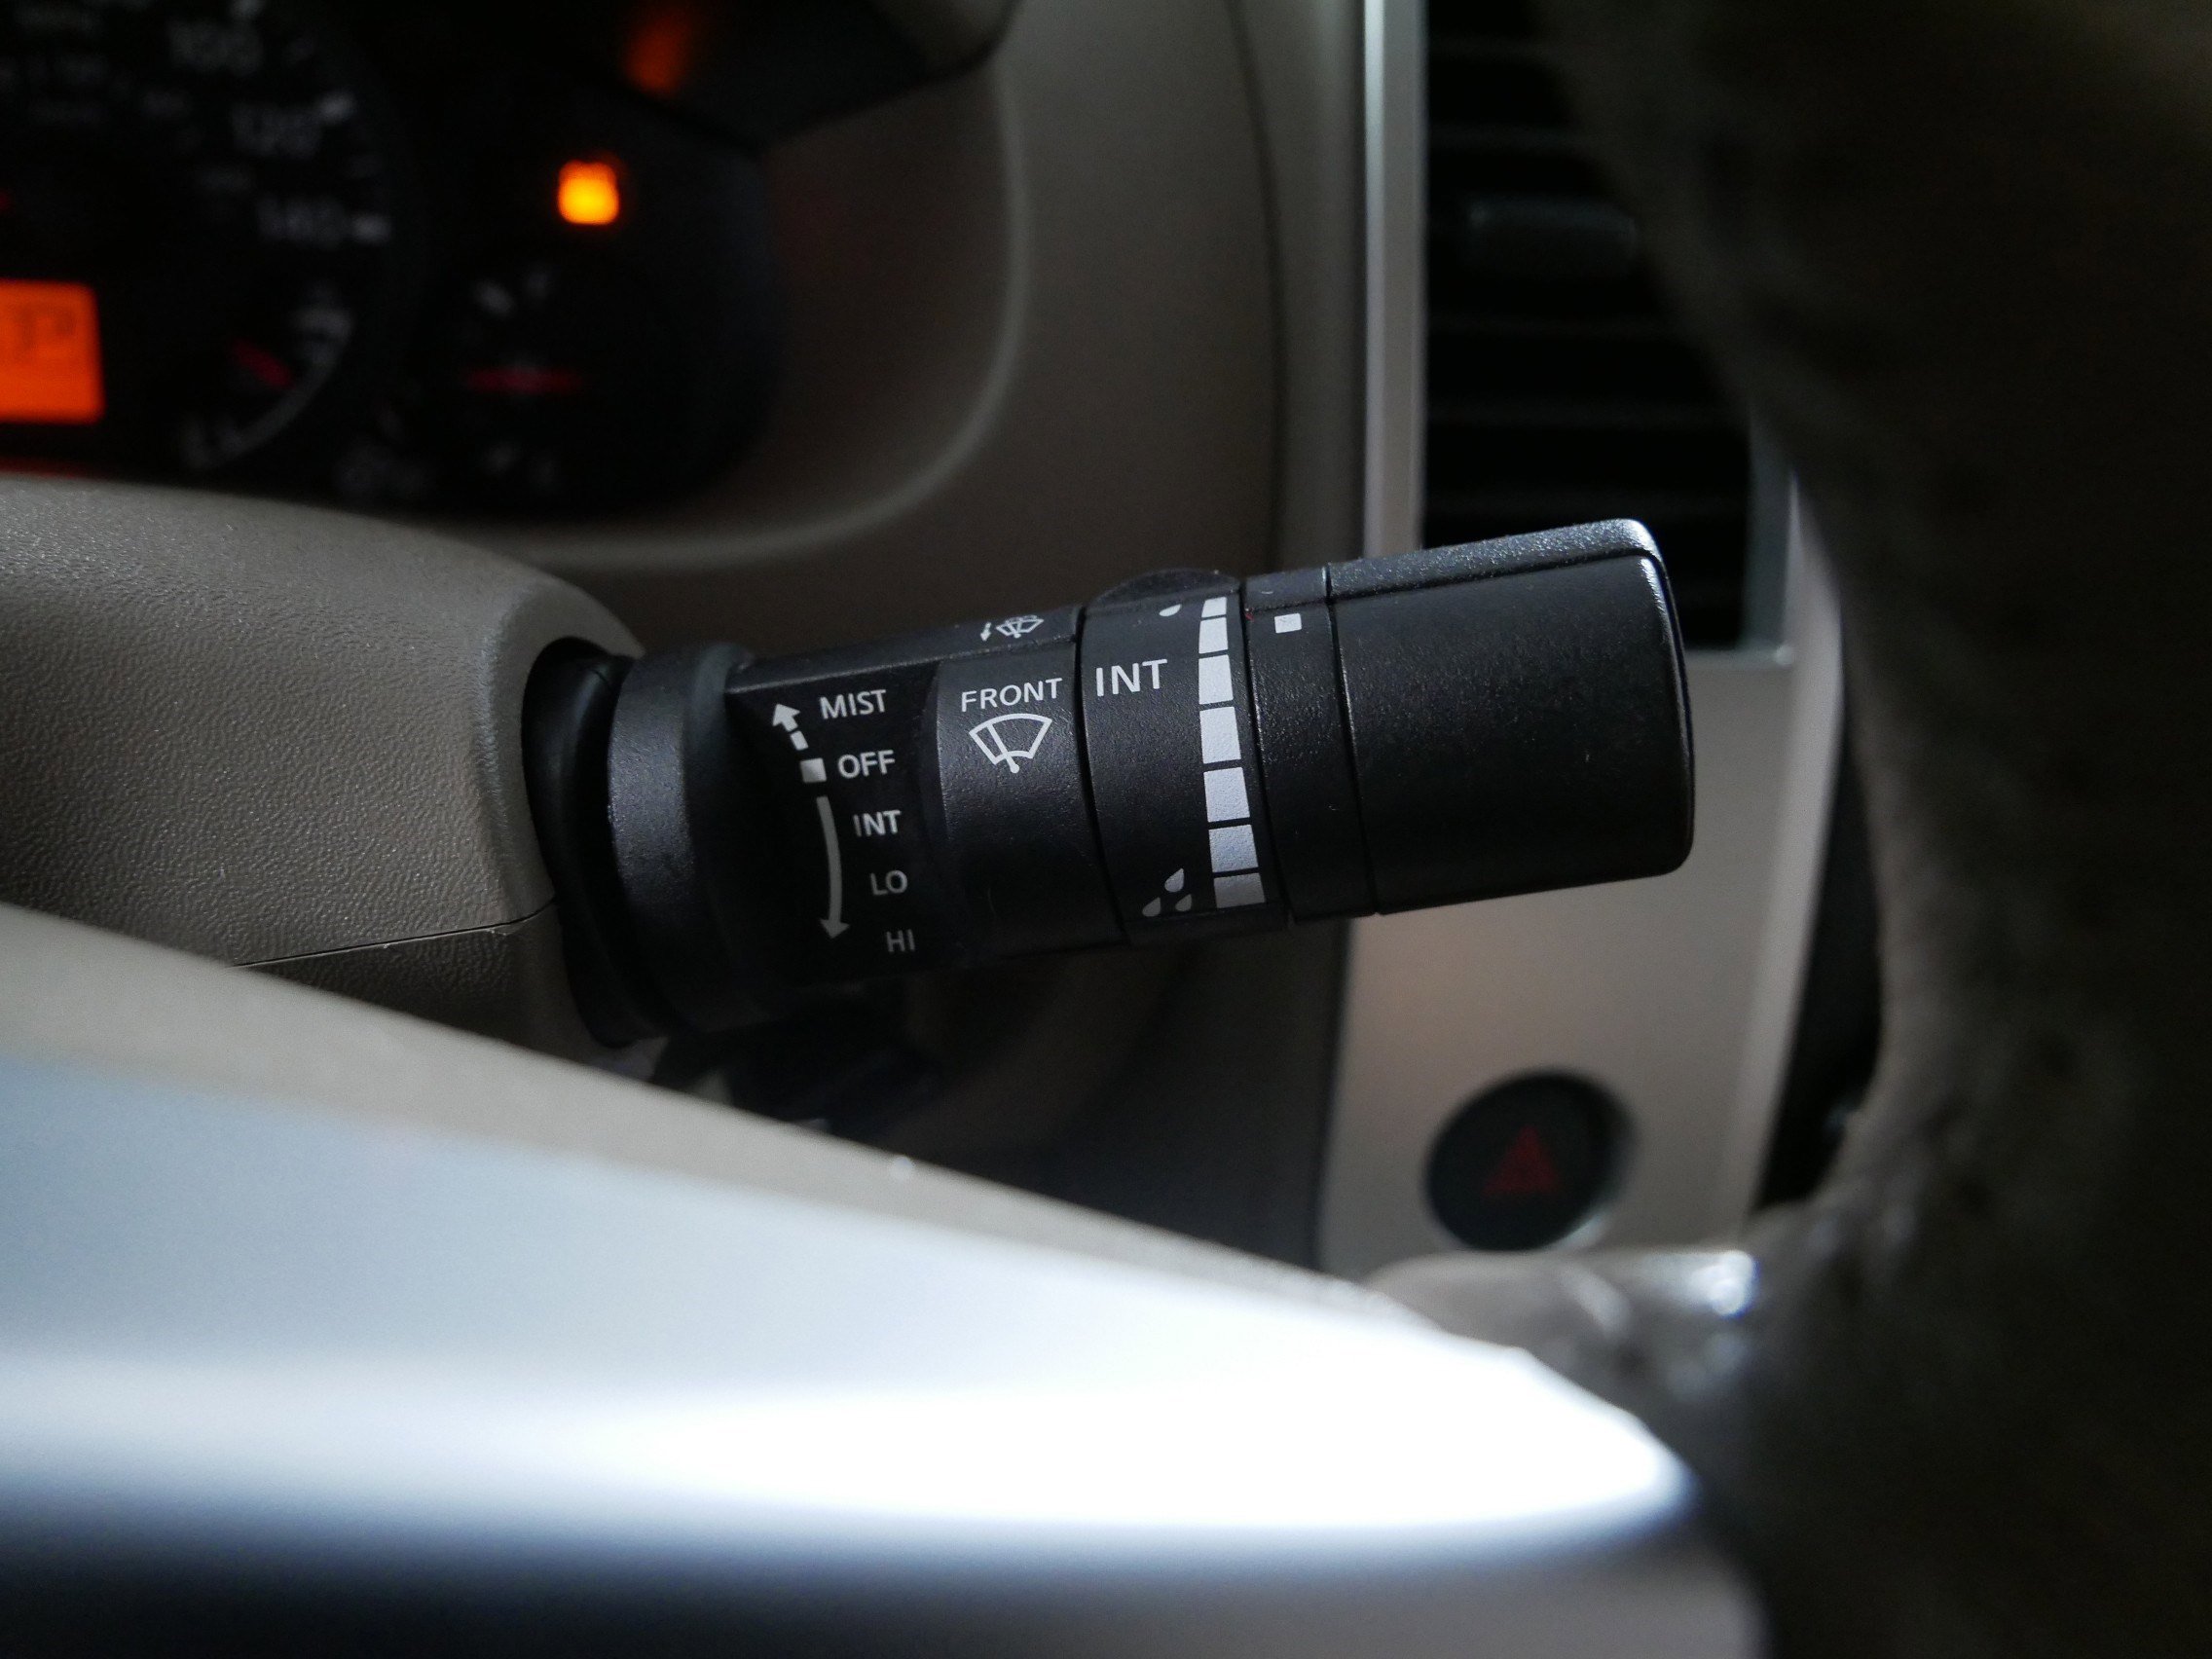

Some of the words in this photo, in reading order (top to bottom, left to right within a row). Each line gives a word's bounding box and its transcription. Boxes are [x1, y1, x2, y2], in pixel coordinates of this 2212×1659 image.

[1095, 658, 1168, 697] INT
[819, 689, 887, 719] MIST
[961, 677, 1063, 713] FRONT
[837, 749, 896, 779] OFF
[853, 809, 902, 837] INT
[870, 869, 908, 896] LO
[886, 929, 915, 953] HI
